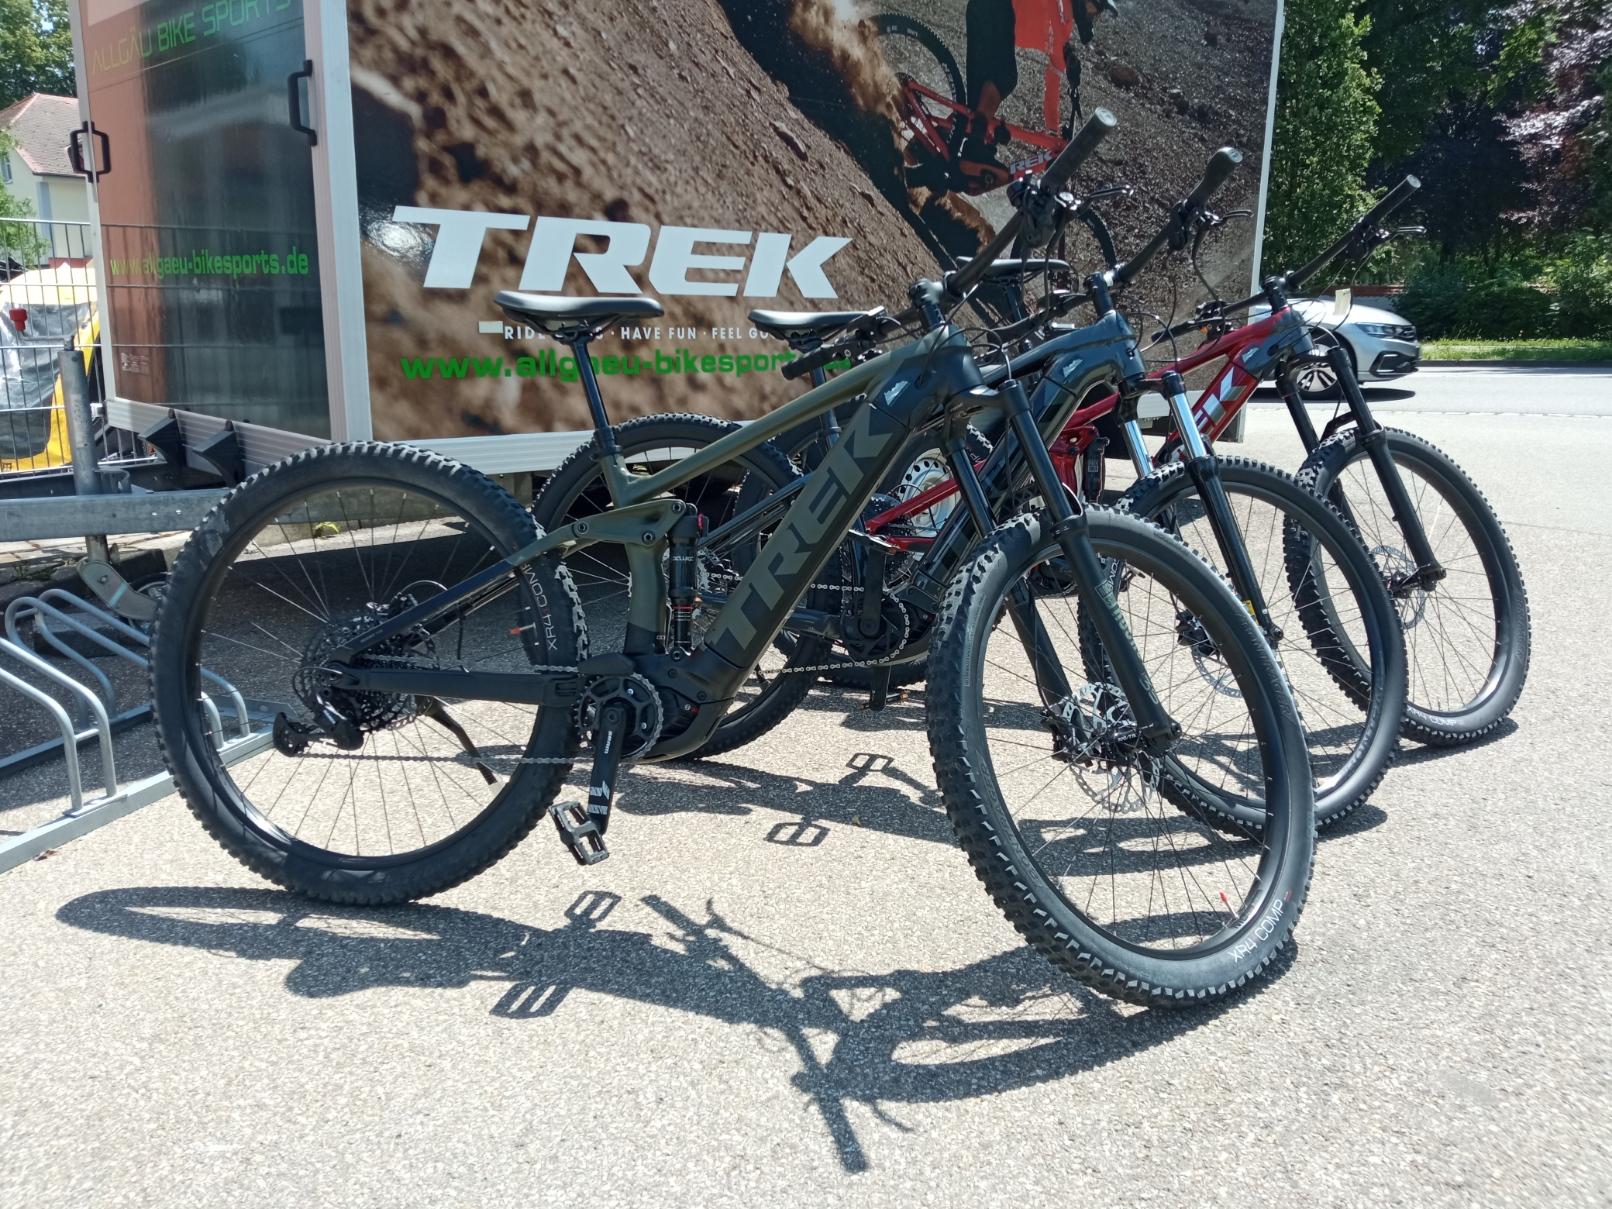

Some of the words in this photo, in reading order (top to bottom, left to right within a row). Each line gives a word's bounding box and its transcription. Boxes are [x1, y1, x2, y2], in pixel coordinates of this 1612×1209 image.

[157, 11, 196, 51] BIKE
[1009, 150, 1053, 175] REK
[392, 205, 853, 299] TREK
[621, 326, 661, 340] HAVE
[668, 327, 697, 340] FUN
[712, 327, 743, 340] FEEL
[749, 327, 773, 340] GO
[705, 401, 894, 650] TREK
[543, 613, 558, 651] XR4
[1226, 939, 1258, 963] XR4
[1254, 899, 1284, 941] COMP
